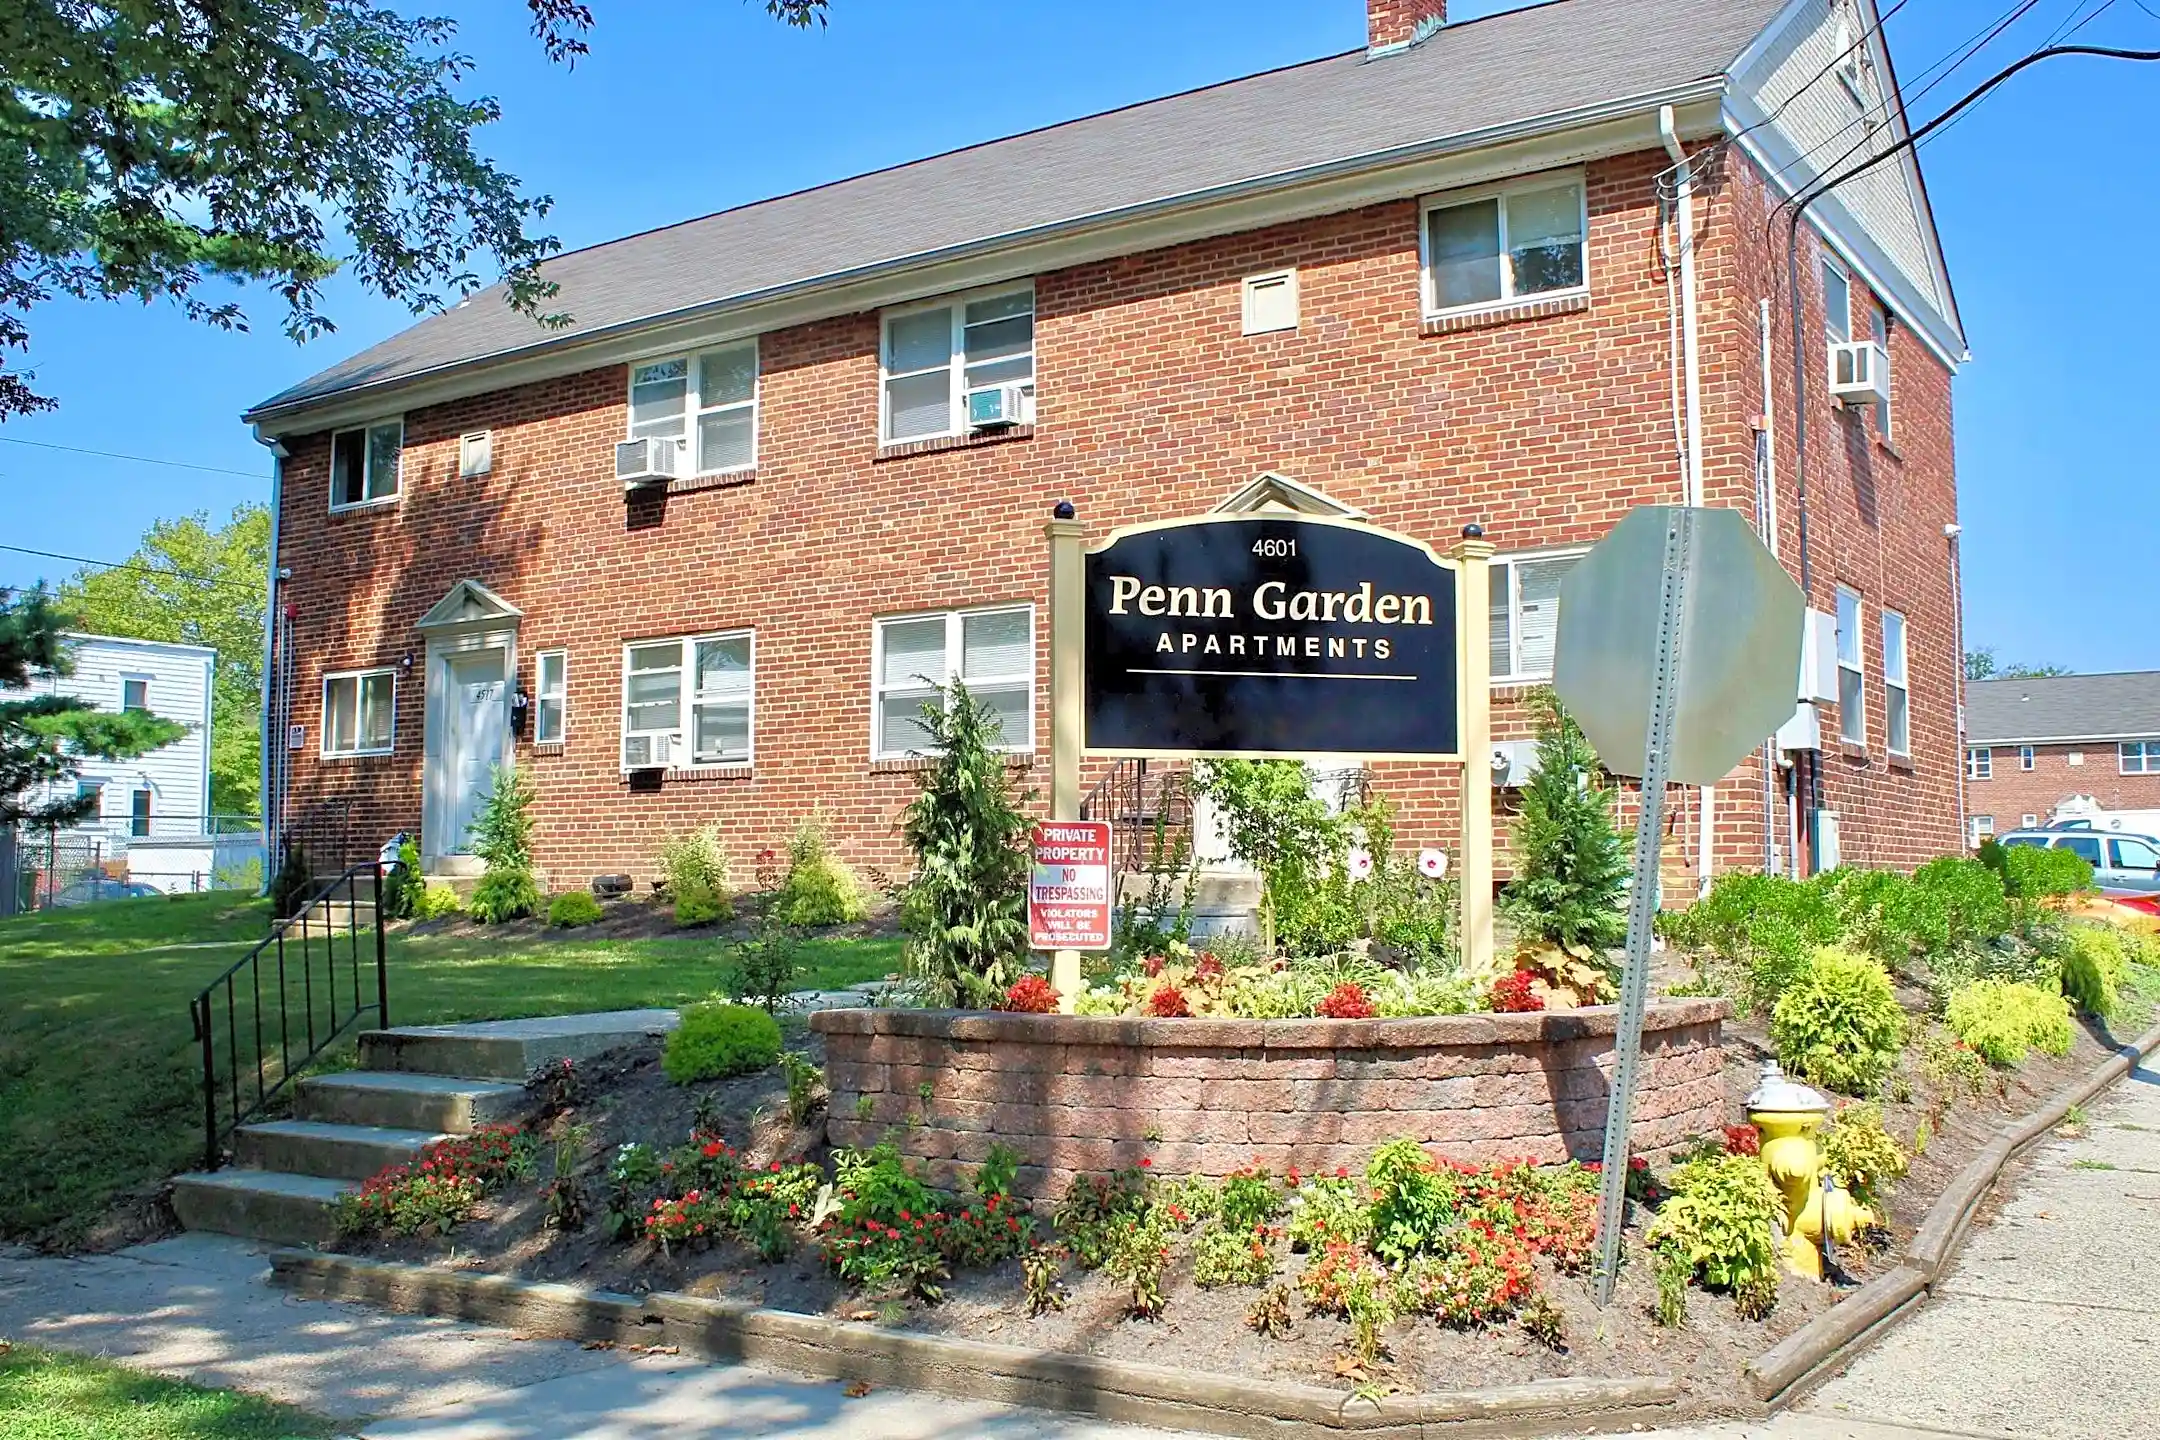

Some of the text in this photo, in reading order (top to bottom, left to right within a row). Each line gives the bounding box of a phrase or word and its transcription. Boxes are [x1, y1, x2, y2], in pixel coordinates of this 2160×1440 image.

[1252, 539, 1296, 557] 4601
[1107, 575, 1433, 626] Penn Garden
[1156, 632, 1391, 660] APARTMENTS
[1043, 828, 1097, 843] PRIVATE
[1034, 846, 1106, 861] PROPERTY
[1062, 868, 1076, 882] NO
[1035, 886, 1104, 901] TRESPASSING
[1040, 908, 1098, 918] VIOLATORS
[1047, 920, 1092, 930] WILL BE
